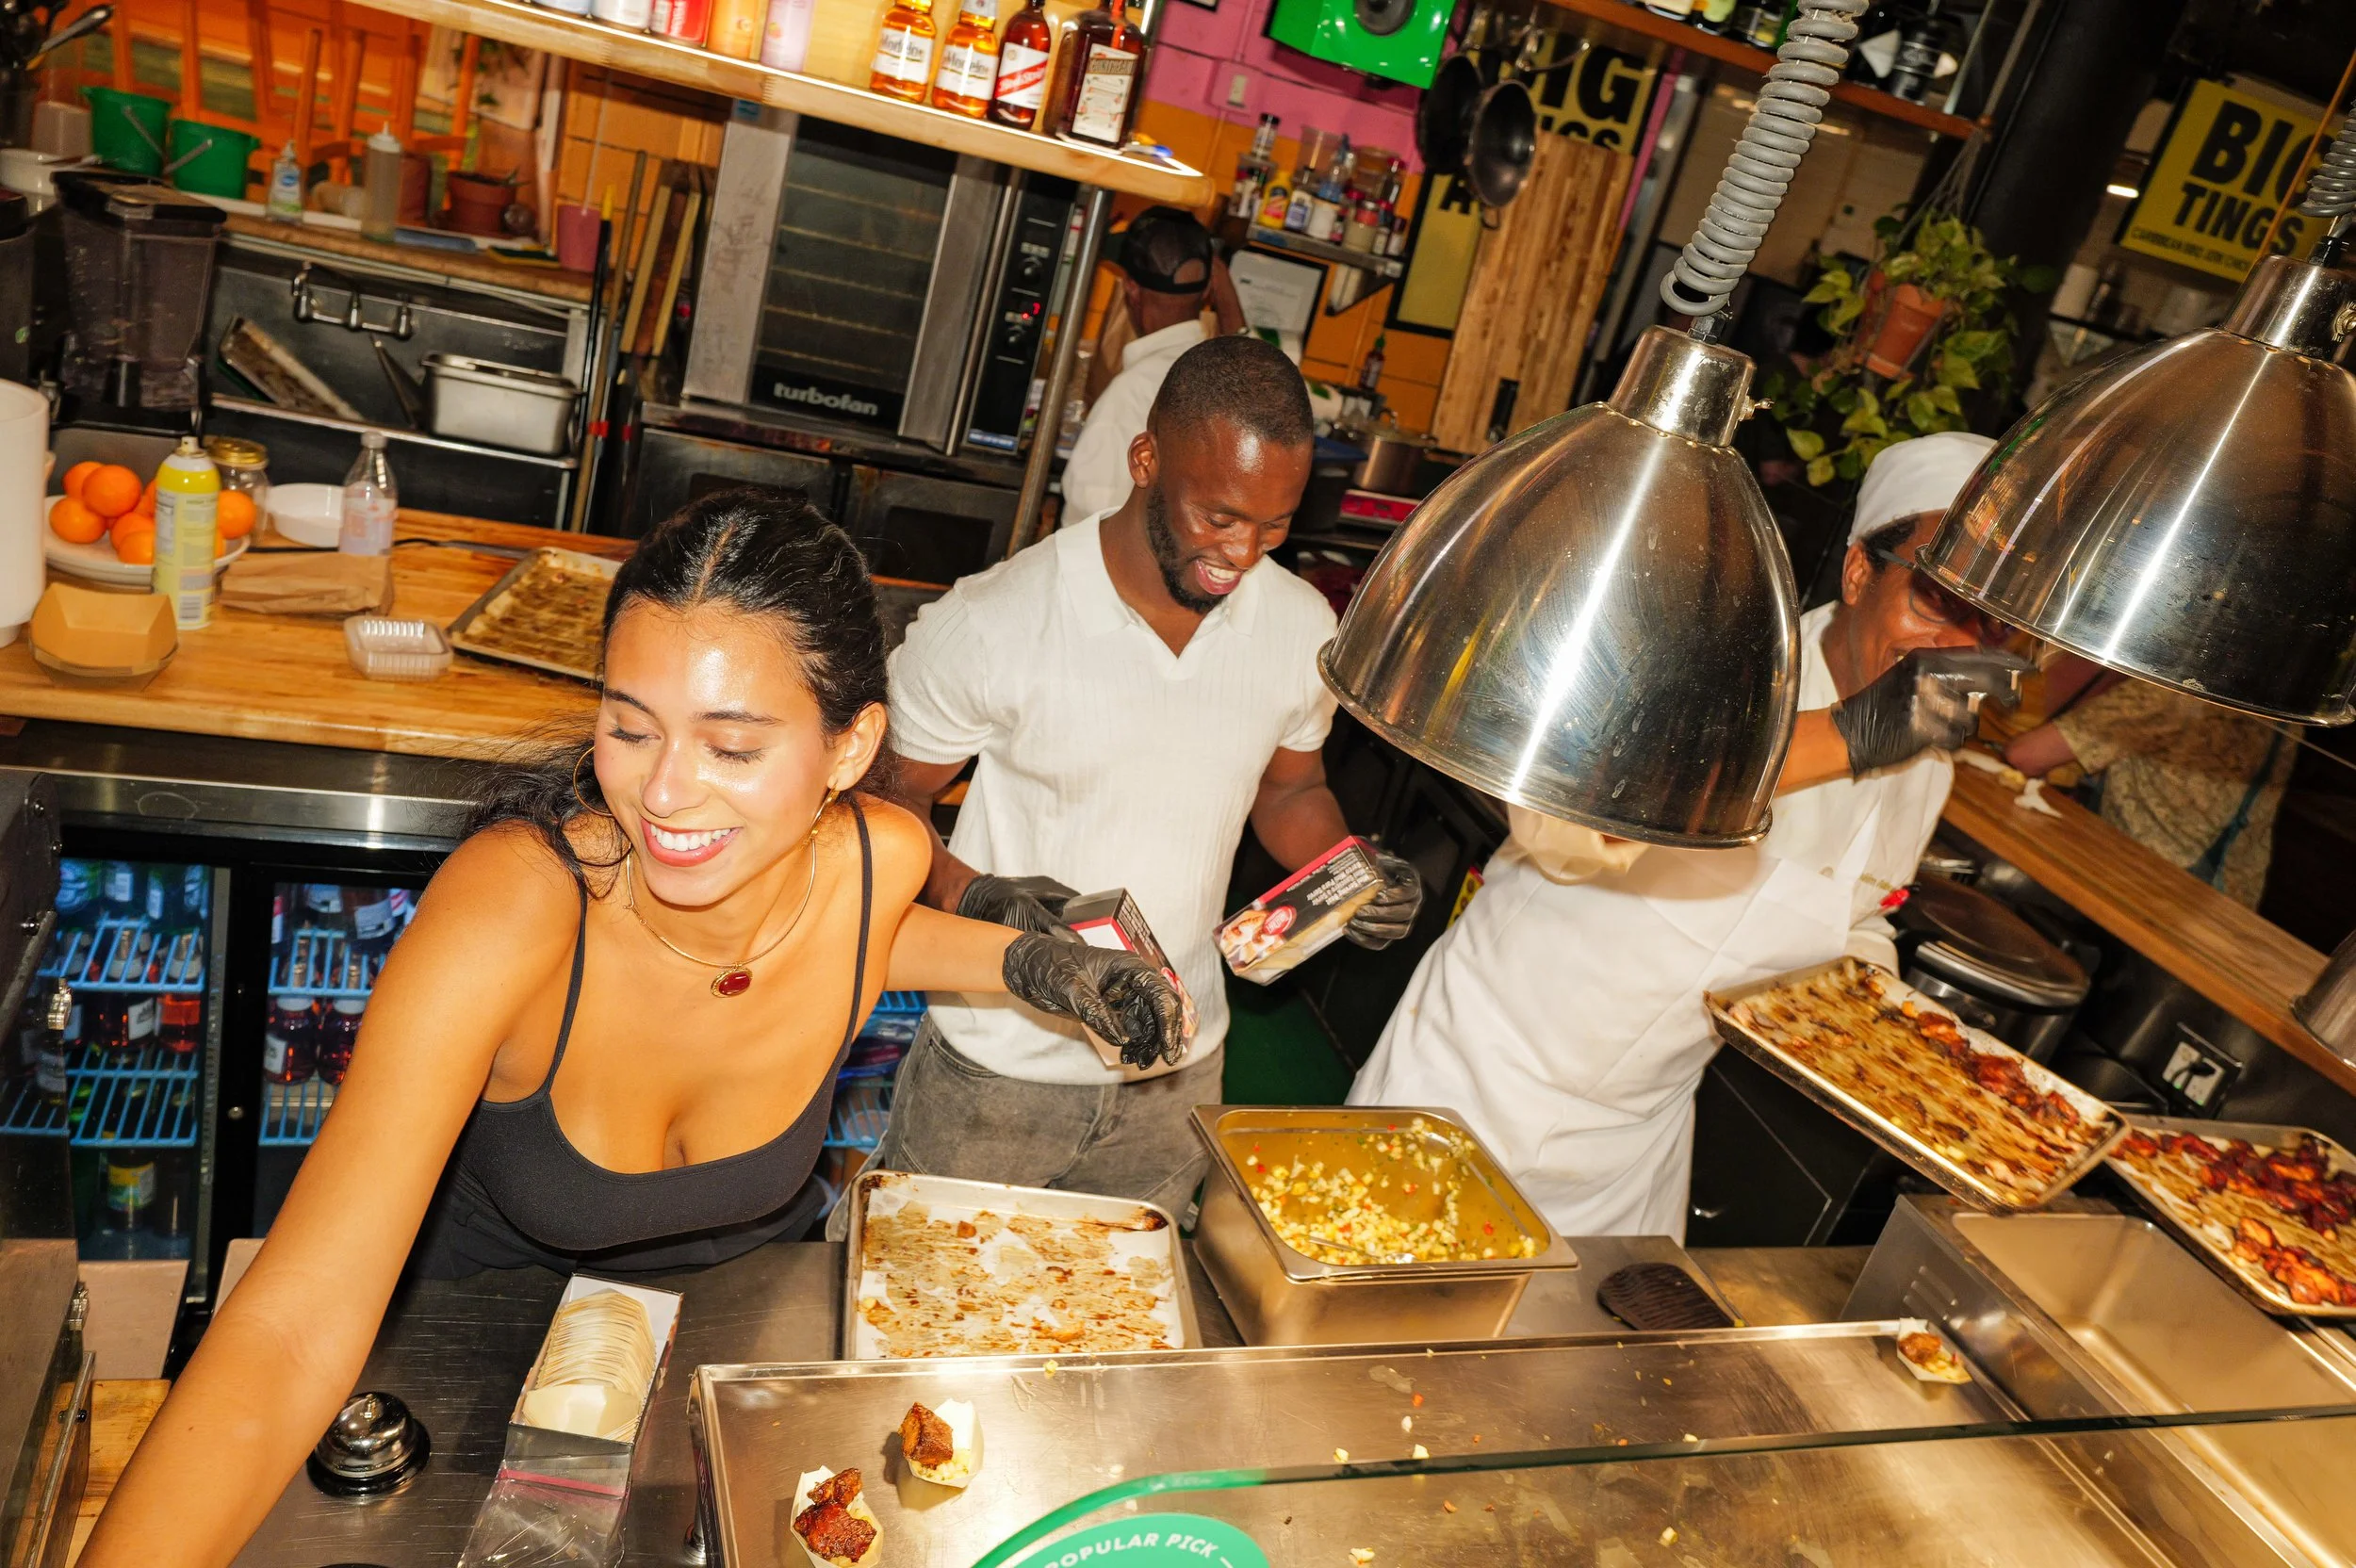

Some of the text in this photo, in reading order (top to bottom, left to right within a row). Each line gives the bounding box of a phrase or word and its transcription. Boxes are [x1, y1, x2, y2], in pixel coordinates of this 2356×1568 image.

[2173, 181, 2304, 256] TINGS
[773, 382, 878, 416] turbofan
[1165, 1533, 1219, 1559] PICK
